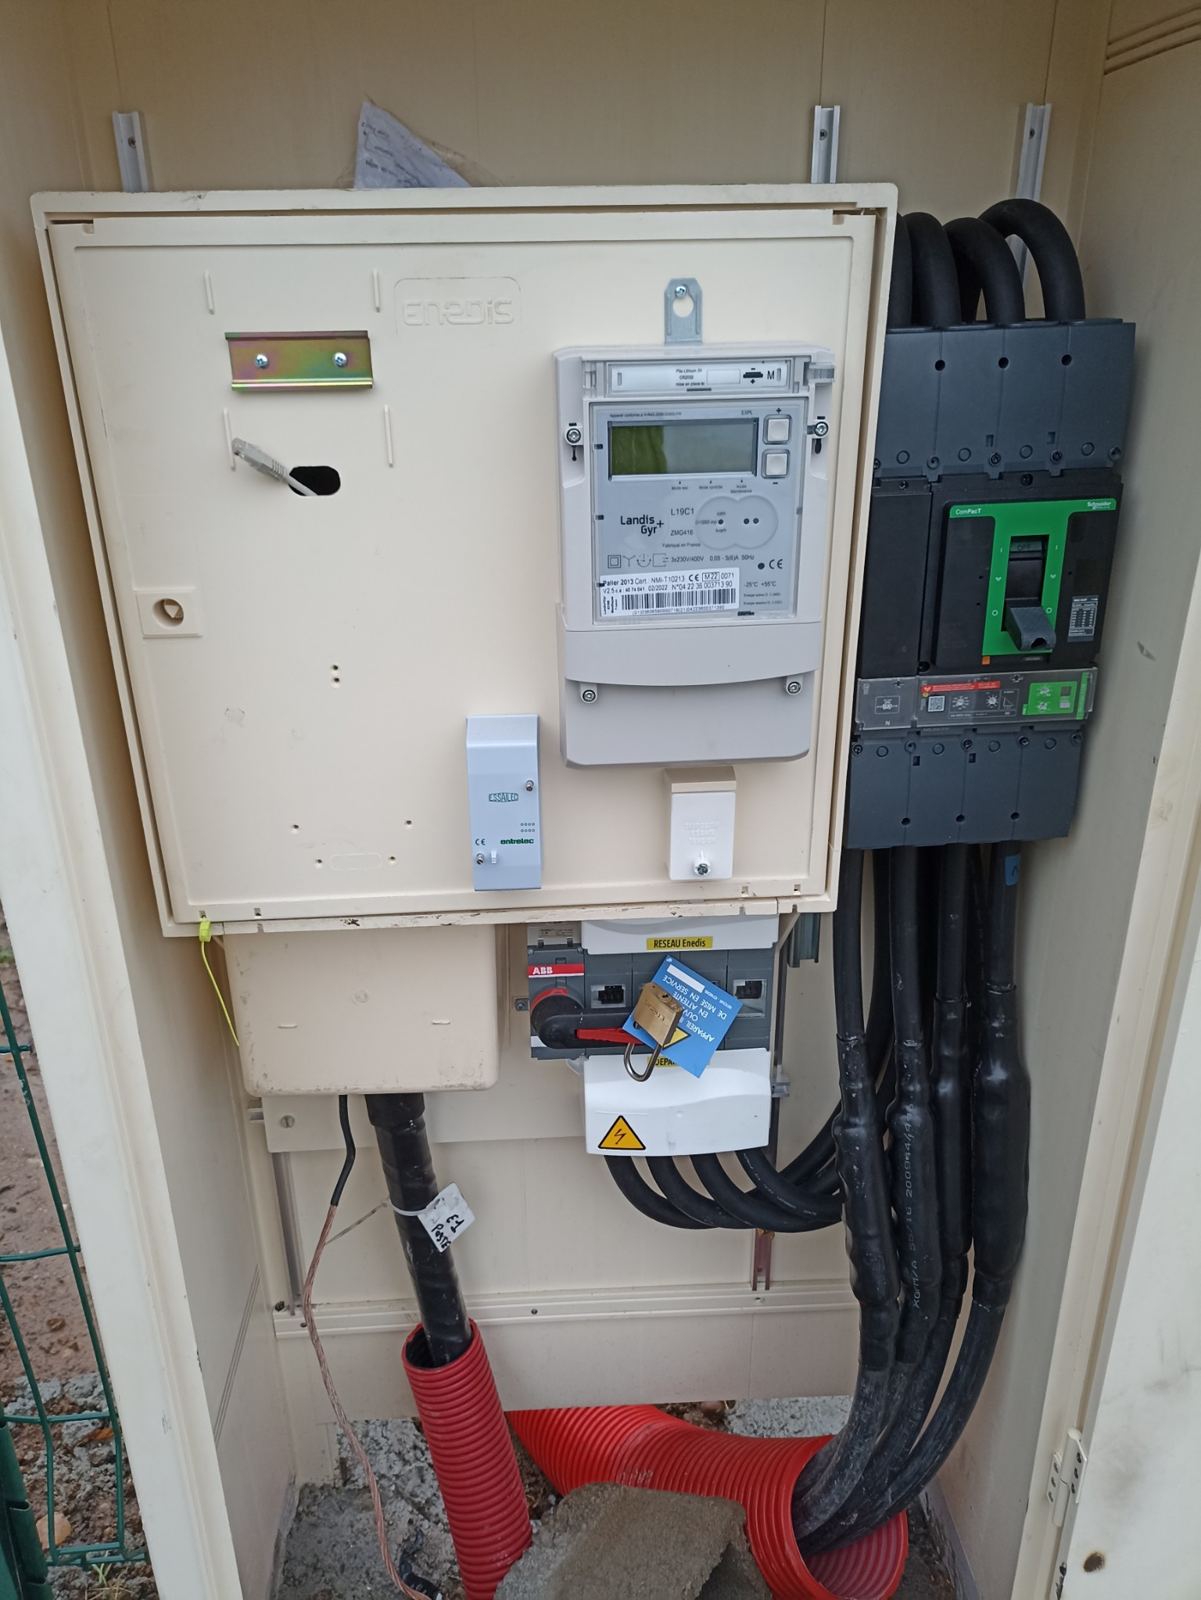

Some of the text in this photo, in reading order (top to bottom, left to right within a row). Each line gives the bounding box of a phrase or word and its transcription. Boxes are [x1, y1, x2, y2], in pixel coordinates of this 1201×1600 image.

[670, 507, 695, 516] L19C1
[955, 508, 982, 516] ComPacT
[620, 514, 655, 525] Landis
[640, 525, 657, 537] Gyr
[653, 938, 706, 949] RESEAU Enedis
[532, 966, 553, 975] ABB
[661, 974, 690, 995] SERVICE
[671, 991, 699, 1011] ATTENTE
[688, 992, 701, 1002] EN
[699, 998, 718, 1013] MISE
[698, 1007, 709, 1019] EN
[716, 1008, 729, 1020] DE
[684, 1020, 715, 1043] APPAREIL
